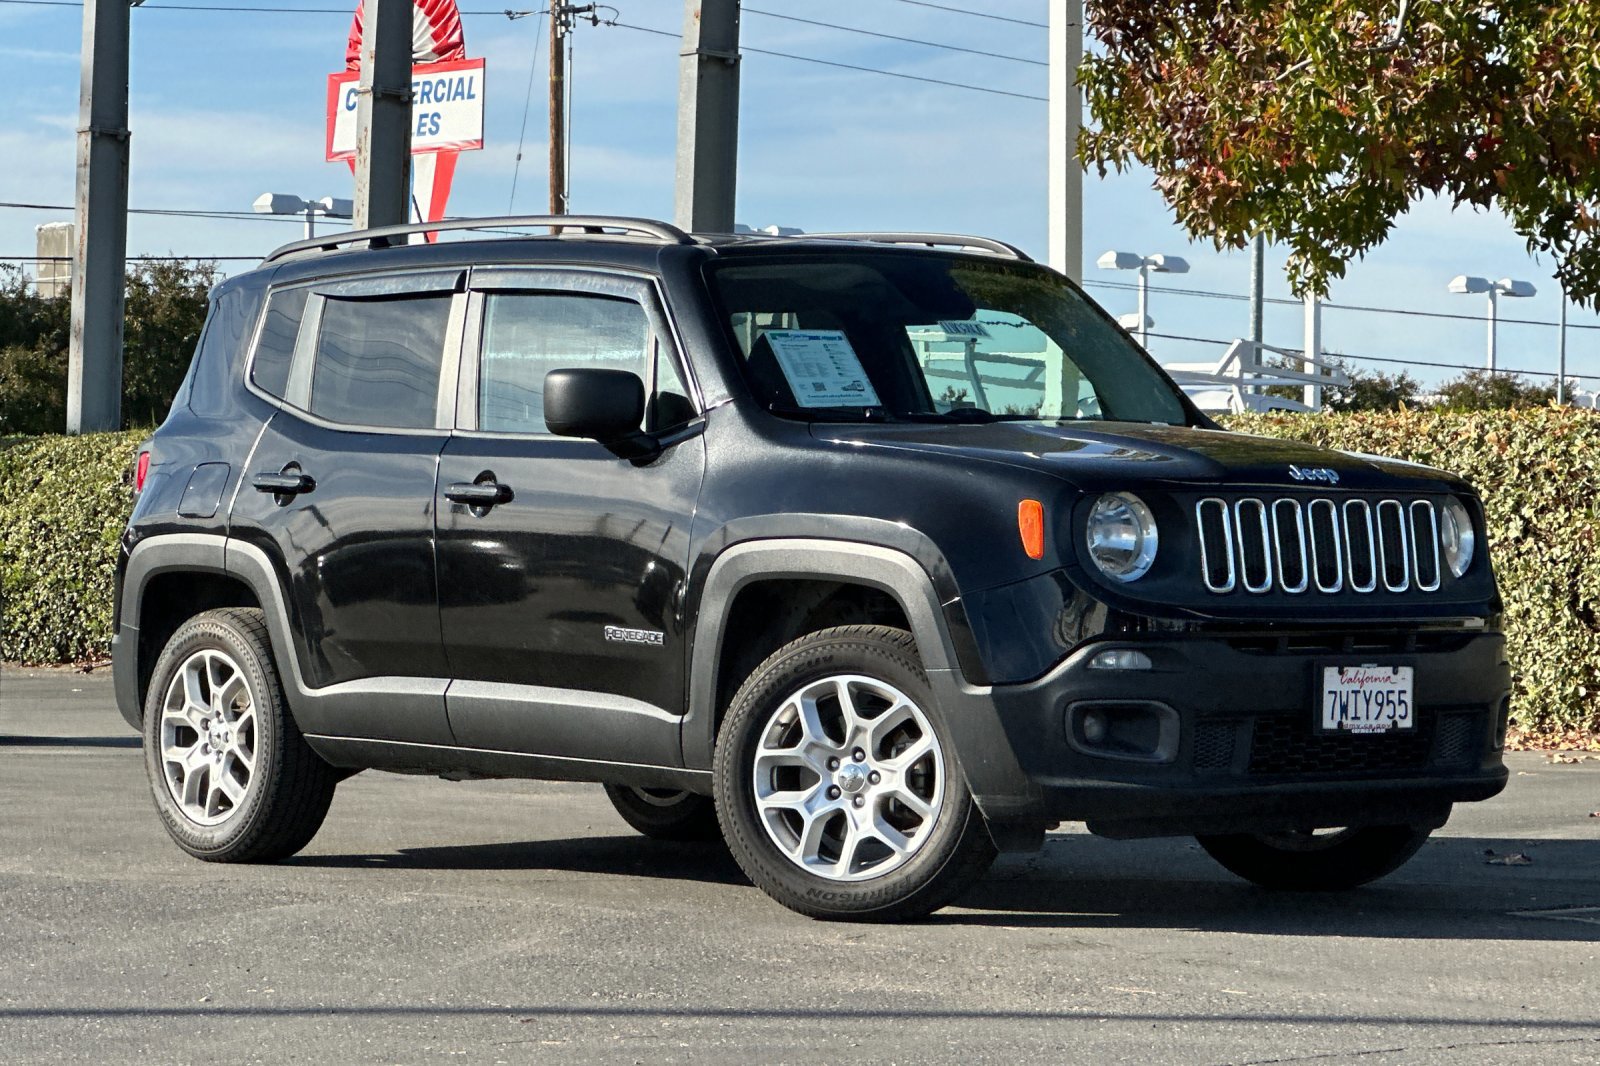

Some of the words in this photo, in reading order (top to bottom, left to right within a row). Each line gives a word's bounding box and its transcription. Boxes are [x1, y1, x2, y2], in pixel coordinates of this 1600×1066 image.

[345, 76, 476, 112] CERCIAL
[1289, 464, 1340, 484] Jeep
[605, 626, 664, 645] RENEGADE
[1341, 669, 1398, 689] California
[1328, 690, 1408, 720] 7WIY955
